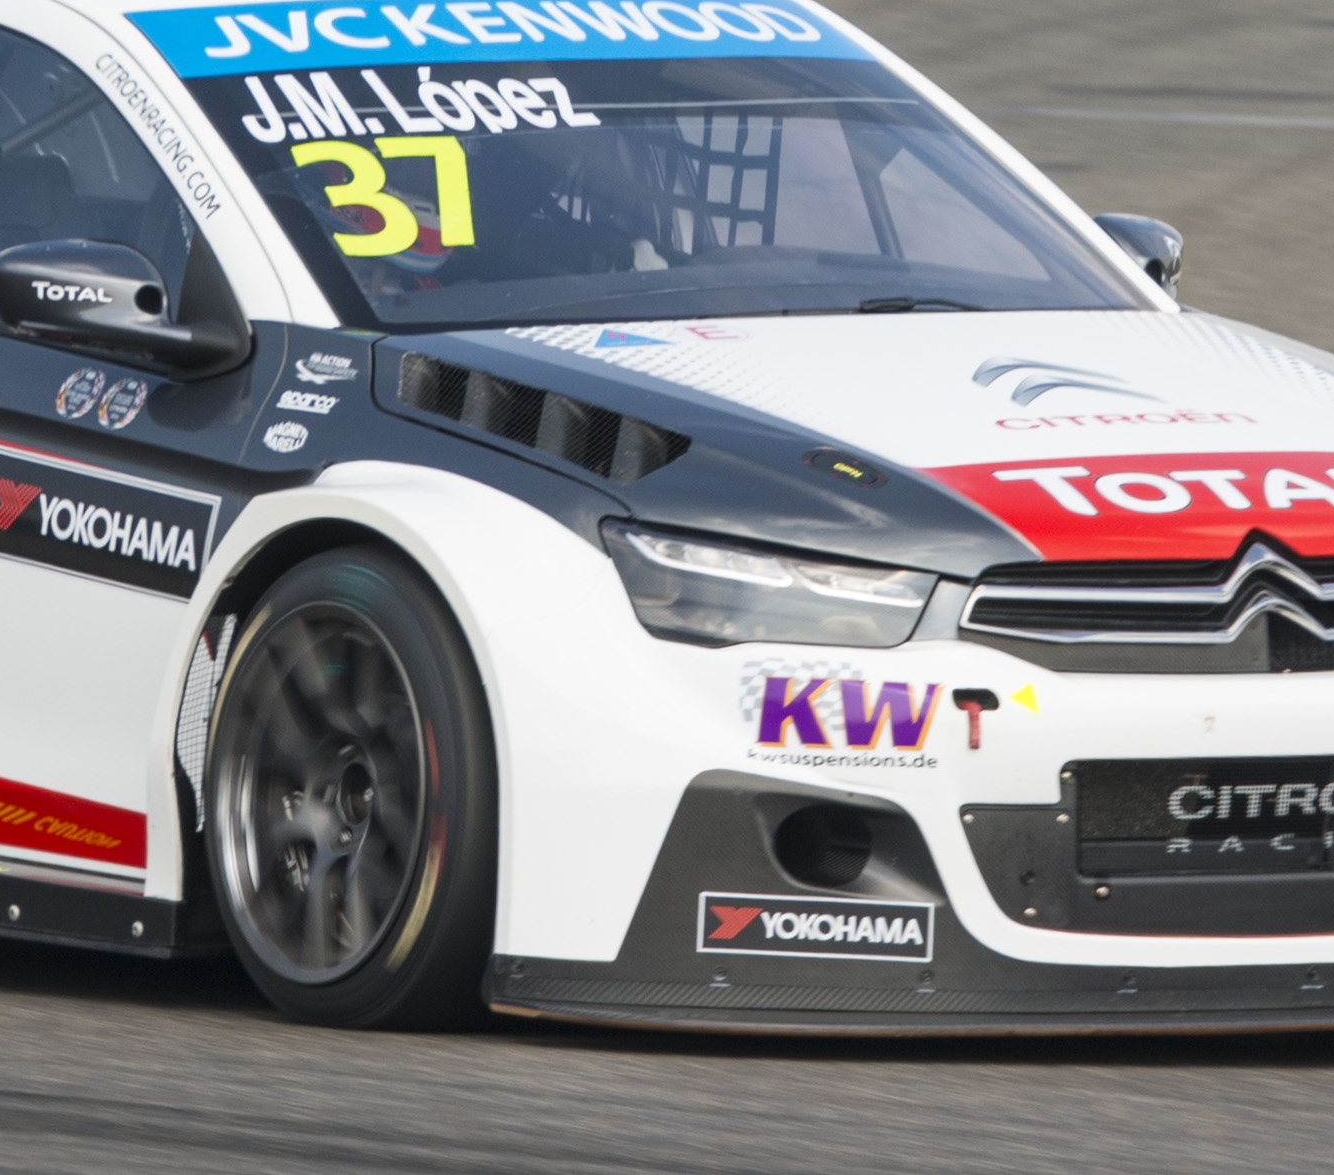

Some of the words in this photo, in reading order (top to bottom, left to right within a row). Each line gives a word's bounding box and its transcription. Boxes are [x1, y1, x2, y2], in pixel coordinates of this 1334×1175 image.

[95, 53, 222, 221] CITROENRACING.COM
[241, 69, 385, 144] J.M.
[361, 66, 601, 134] López
[291, 135, 475, 257] 37
[31, 279, 113, 303] TOTAL
[39, 493, 195, 572] YOKOHAMA
[757, 676, 942, 751] KW
[747, 748, 938, 769] kwsuspensions.de
[761, 911, 924, 946] YOKOHAMA
